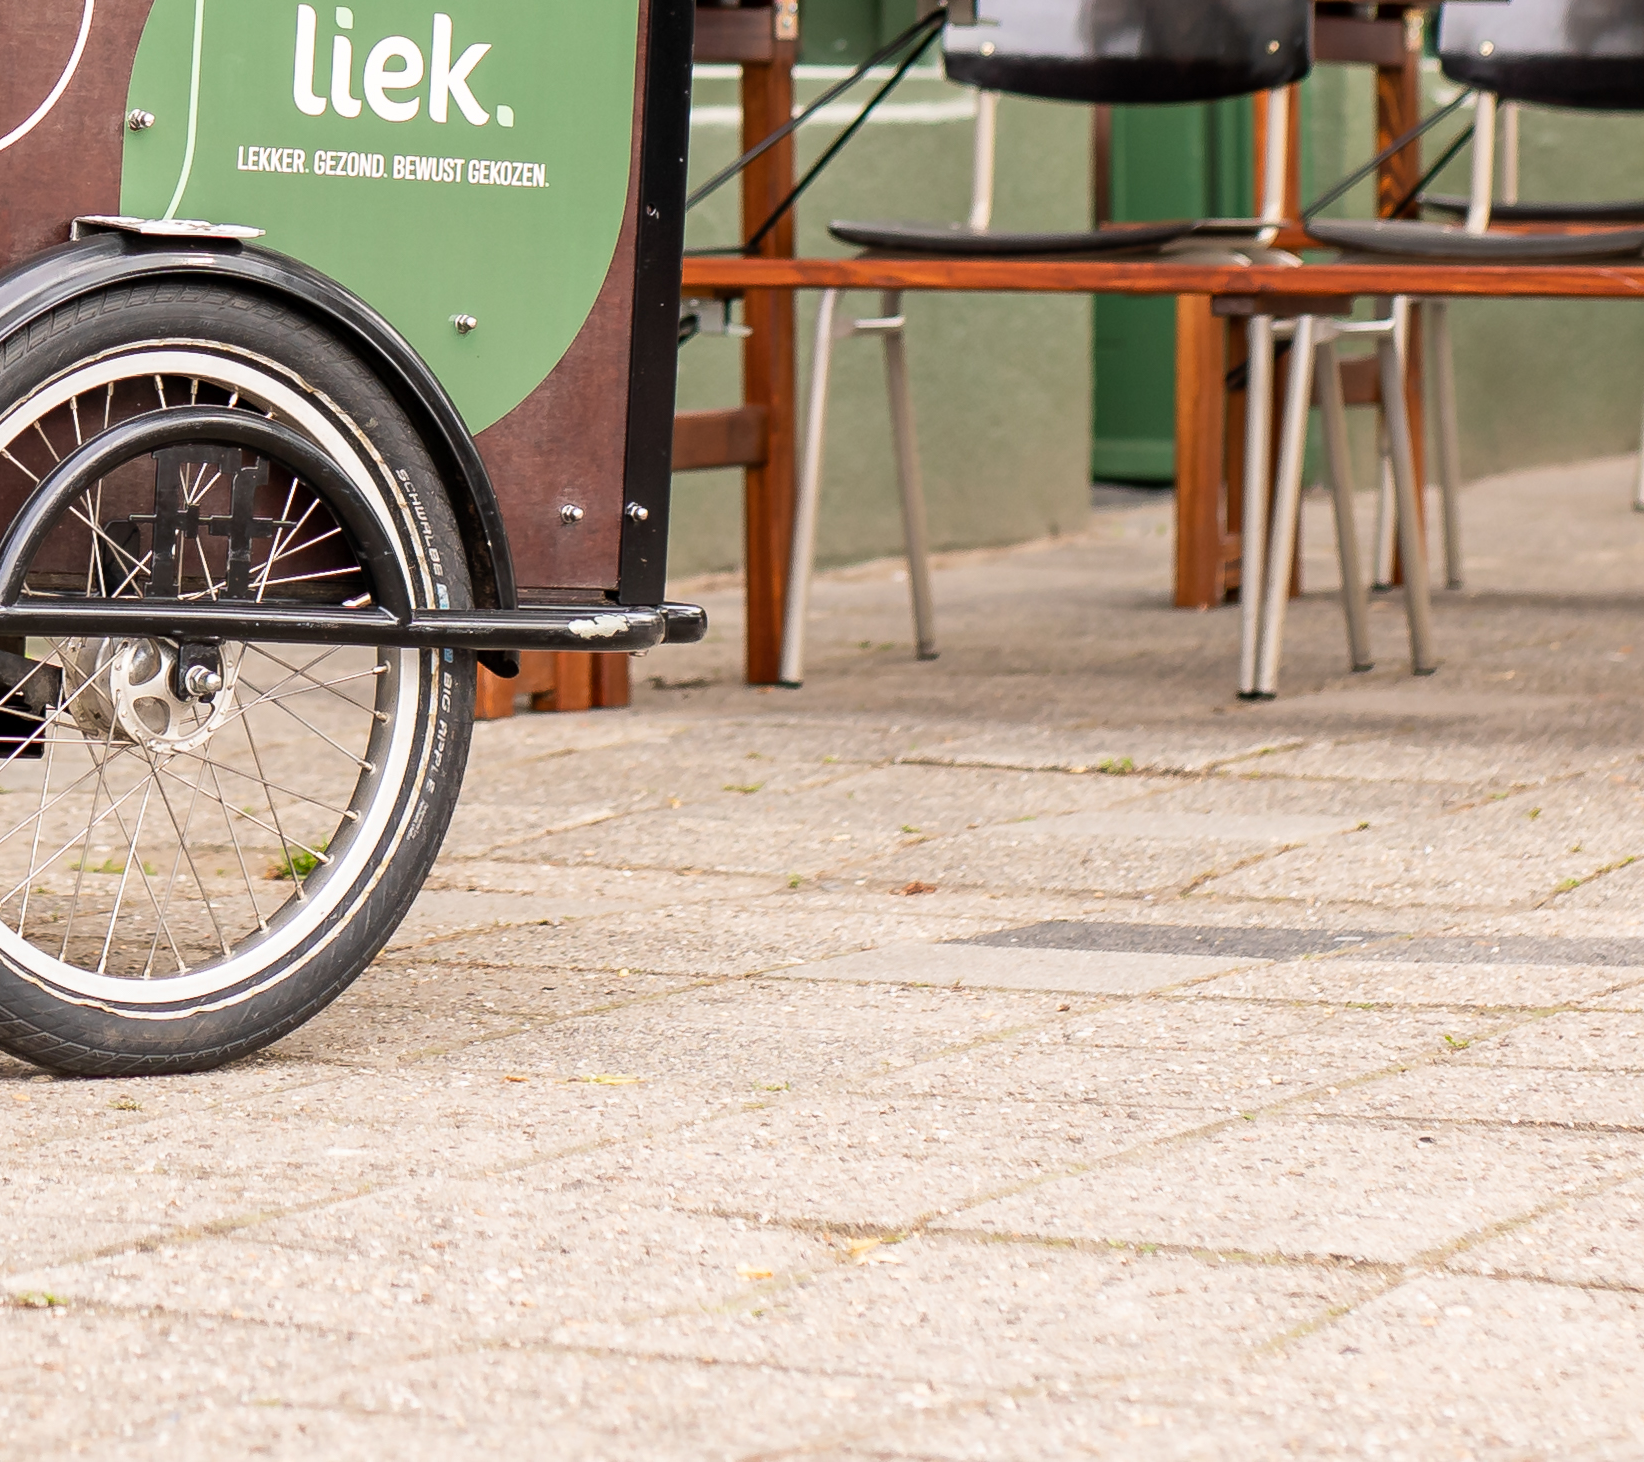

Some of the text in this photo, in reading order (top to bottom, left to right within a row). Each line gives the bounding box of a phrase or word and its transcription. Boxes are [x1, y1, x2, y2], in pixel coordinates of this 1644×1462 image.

[292, 3, 515, 127] liek.
[237, 145, 550, 189] LEKKER. GEZOND. BEWUST GEKOZEN.
[395, 468, 443, 577] SCHWALBE
